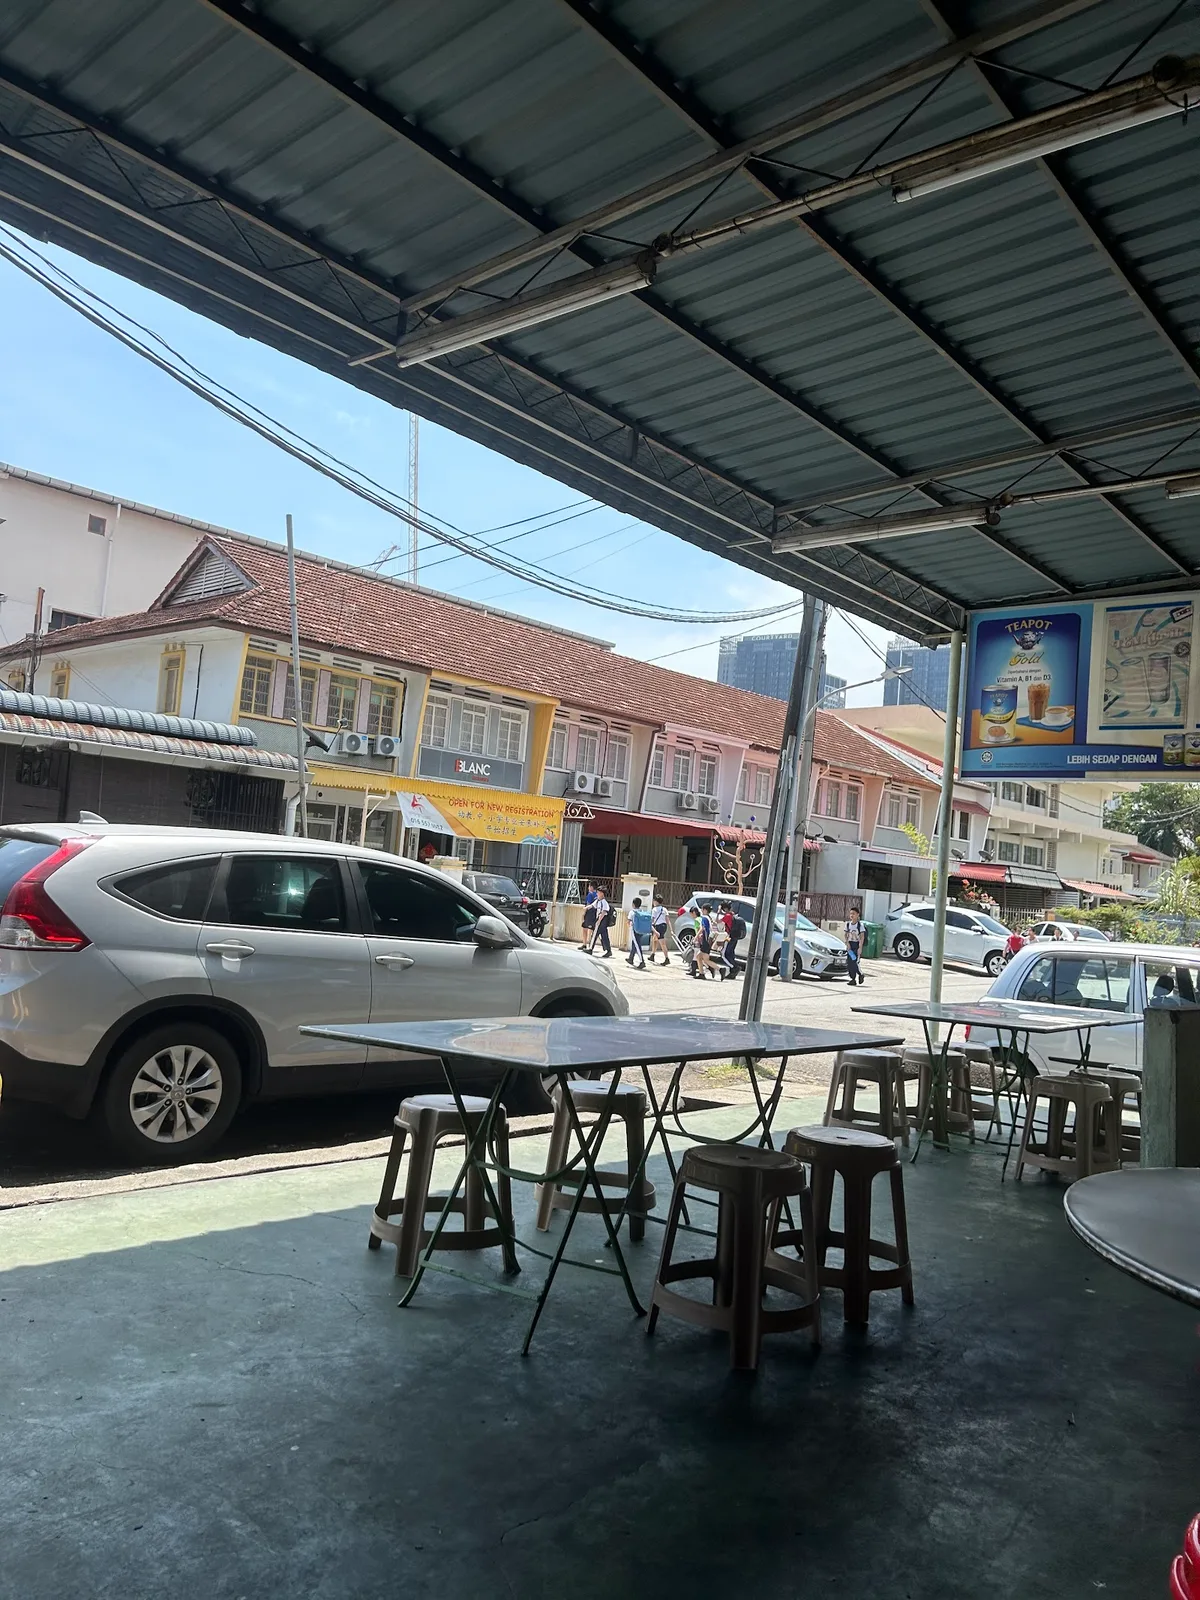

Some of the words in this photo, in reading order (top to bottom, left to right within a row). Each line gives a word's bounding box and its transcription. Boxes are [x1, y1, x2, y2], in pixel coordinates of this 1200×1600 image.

[1005, 619, 1053, 633] TEAPOT
[1008, 652, 1045, 666] Gold
[1067, 754, 1091, 764] LEBIH
[1092, 754, 1120, 764] SEDAP
[1121, 754, 1158, 764] DENGAN
[455, 759, 491, 776] BLANC
[448, 799, 468, 808] OPEN
[471, 801, 485, 810] FOR
[487, 802, 503, 812] NEW
[505, 805, 555, 818] REGISTRATION
